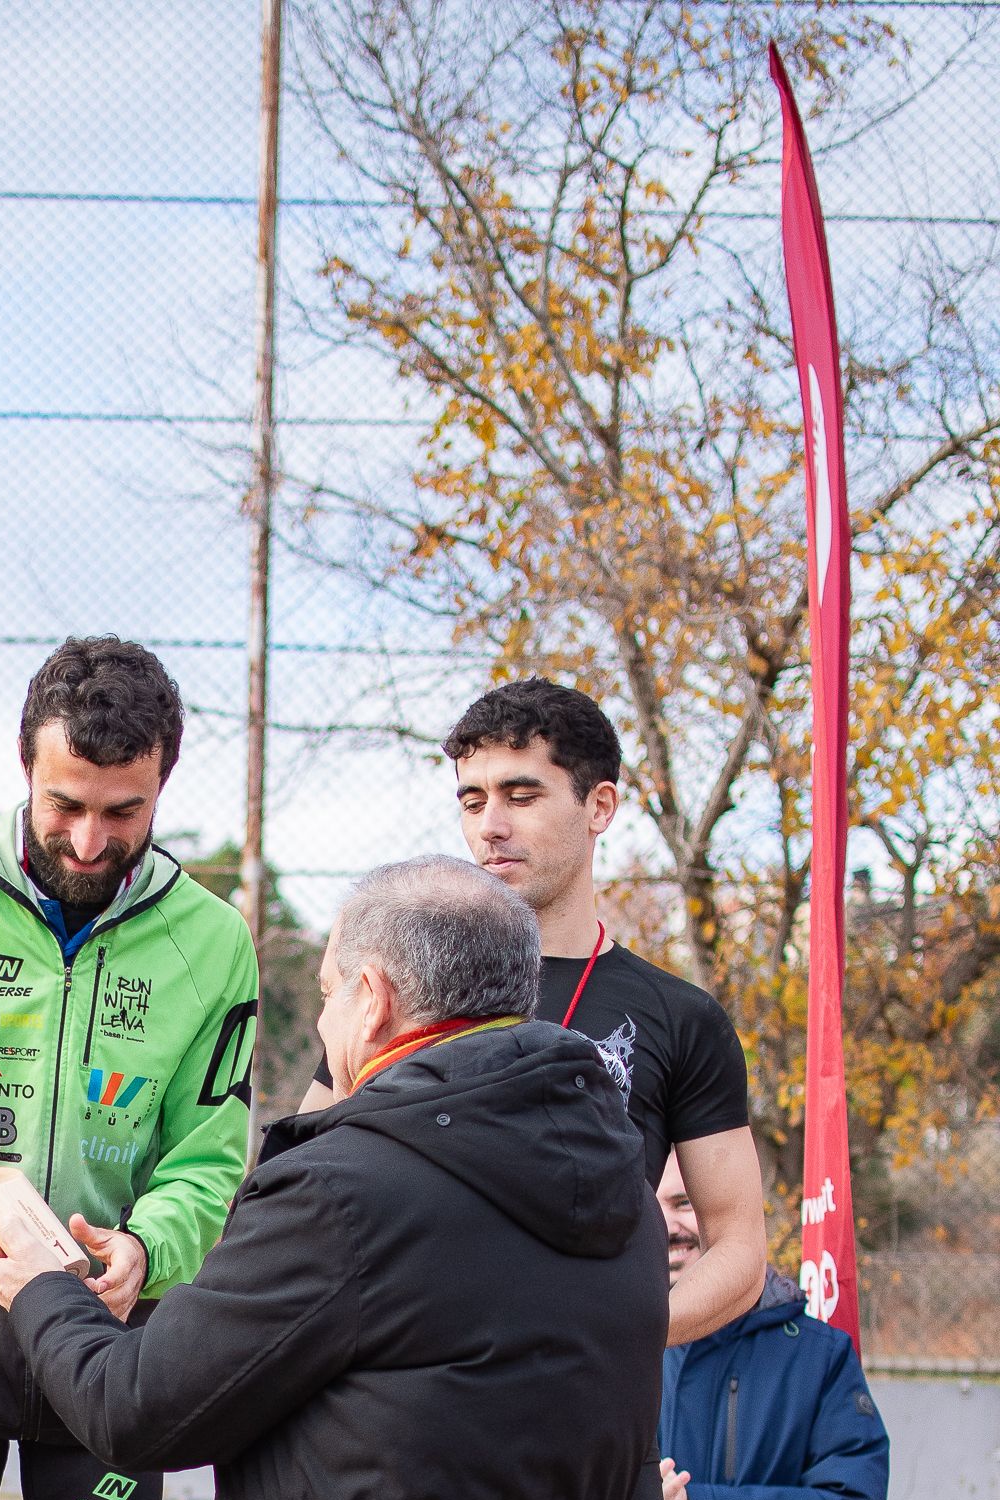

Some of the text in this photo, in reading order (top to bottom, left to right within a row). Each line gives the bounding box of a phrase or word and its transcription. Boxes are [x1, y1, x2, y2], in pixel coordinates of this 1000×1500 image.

[117, 976, 152, 996] RUN
[104, 991, 150, 1016] WITH
[95, 1475, 135, 1500] IN
